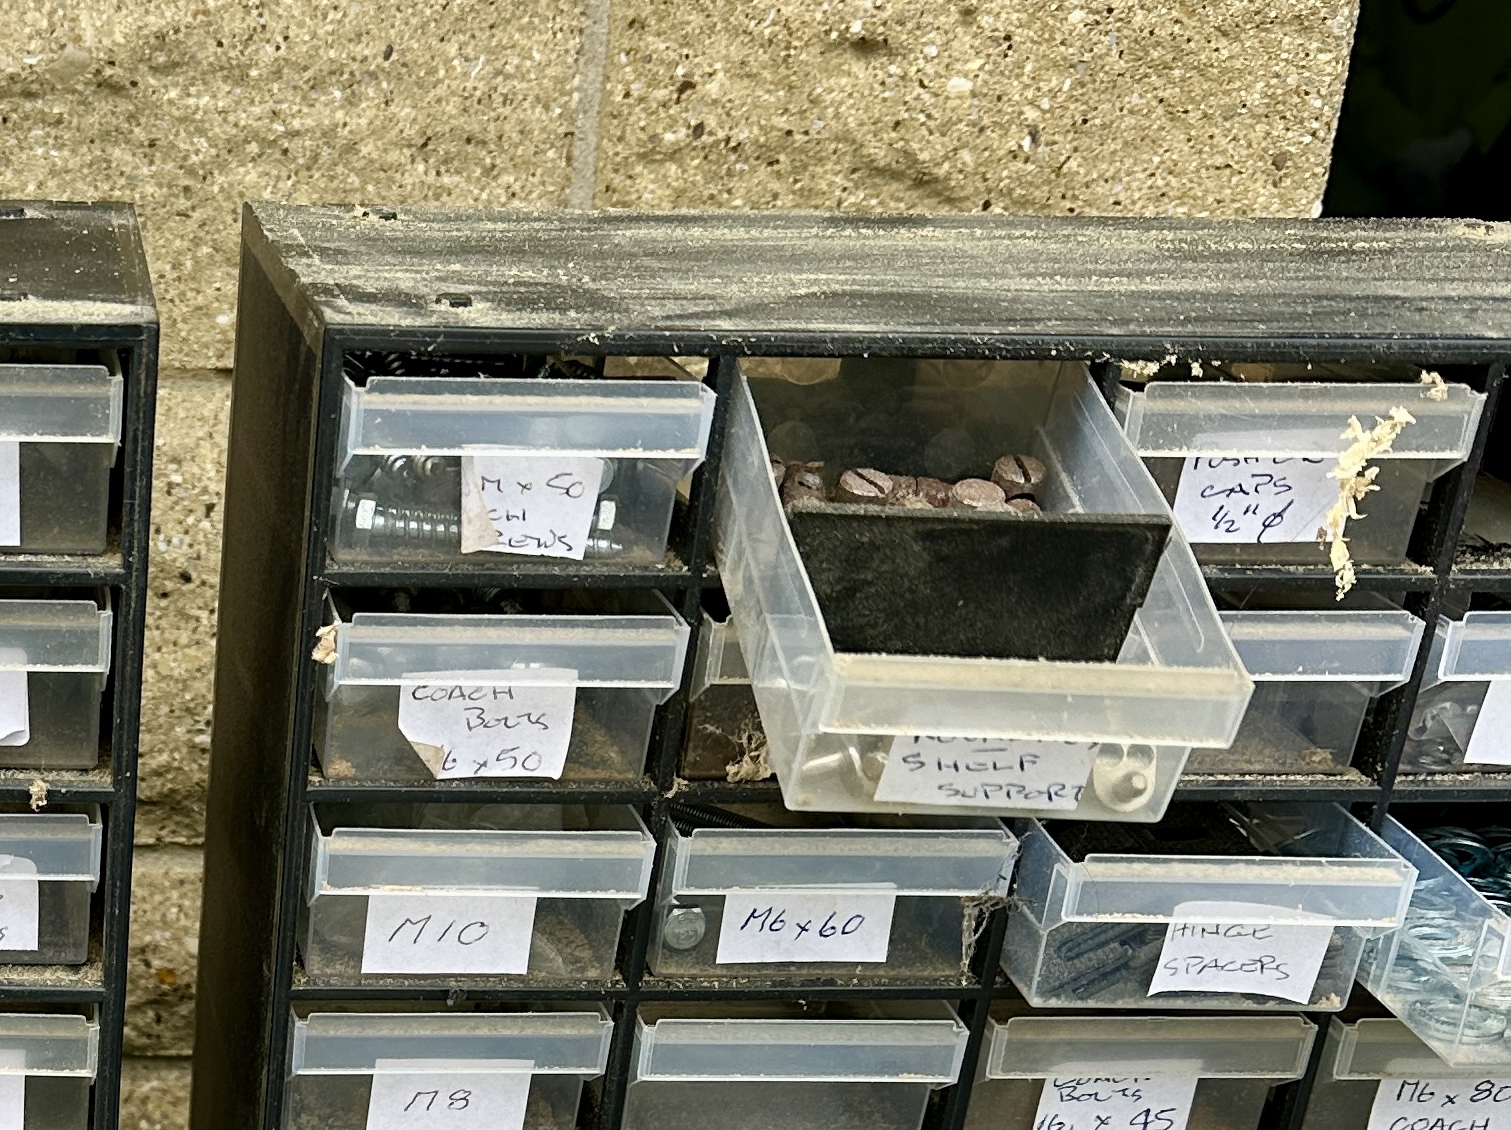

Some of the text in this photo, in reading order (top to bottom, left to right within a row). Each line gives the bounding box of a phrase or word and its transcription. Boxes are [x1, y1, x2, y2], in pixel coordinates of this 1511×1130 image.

[545, 473, 585, 500] 50
[1201, 473, 1294, 499] CAPS
[412, 684, 515, 703] COACH
[494, 748, 543, 773] 50
[901, 752, 1041, 774] SHELF
[937, 783, 1086, 803] SUPPORT
[1171, 922, 1274, 941] HINGE
[1163, 955, 1290, 980] SPACERS
